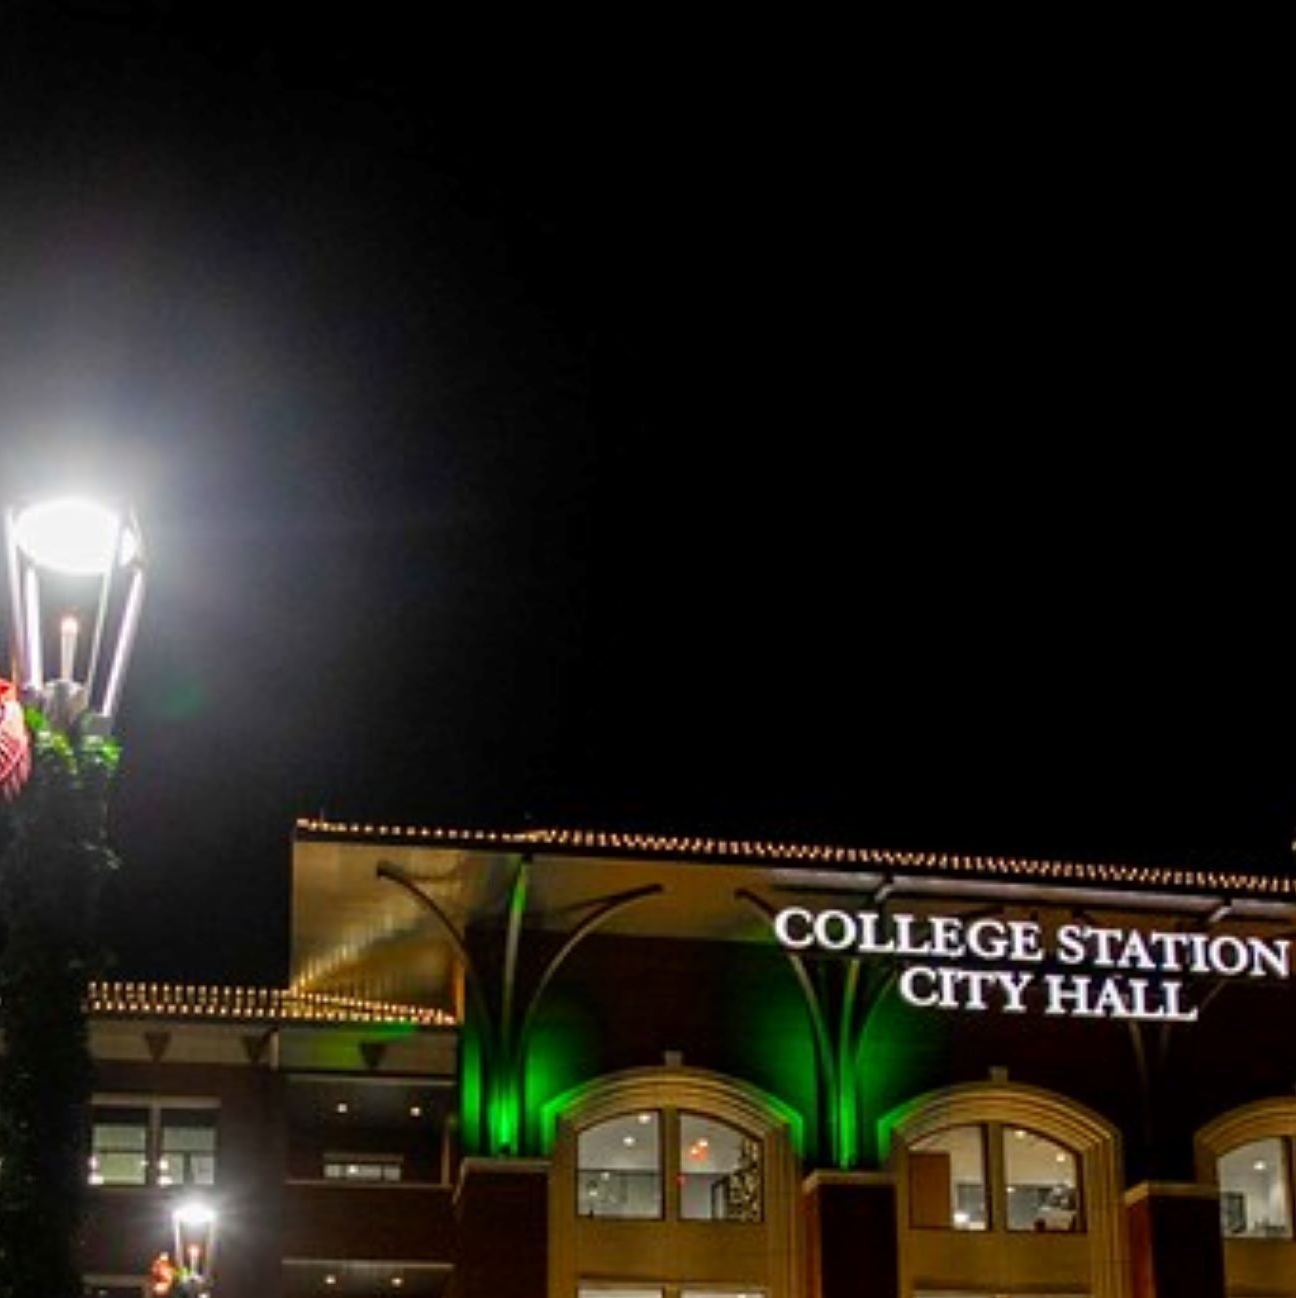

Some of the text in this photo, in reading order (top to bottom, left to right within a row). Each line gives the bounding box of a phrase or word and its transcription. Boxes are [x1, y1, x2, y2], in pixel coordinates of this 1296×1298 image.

[774, 907, 1292, 978] COLLEGE STATION
[900, 967, 1199, 1022] CITY HALL
